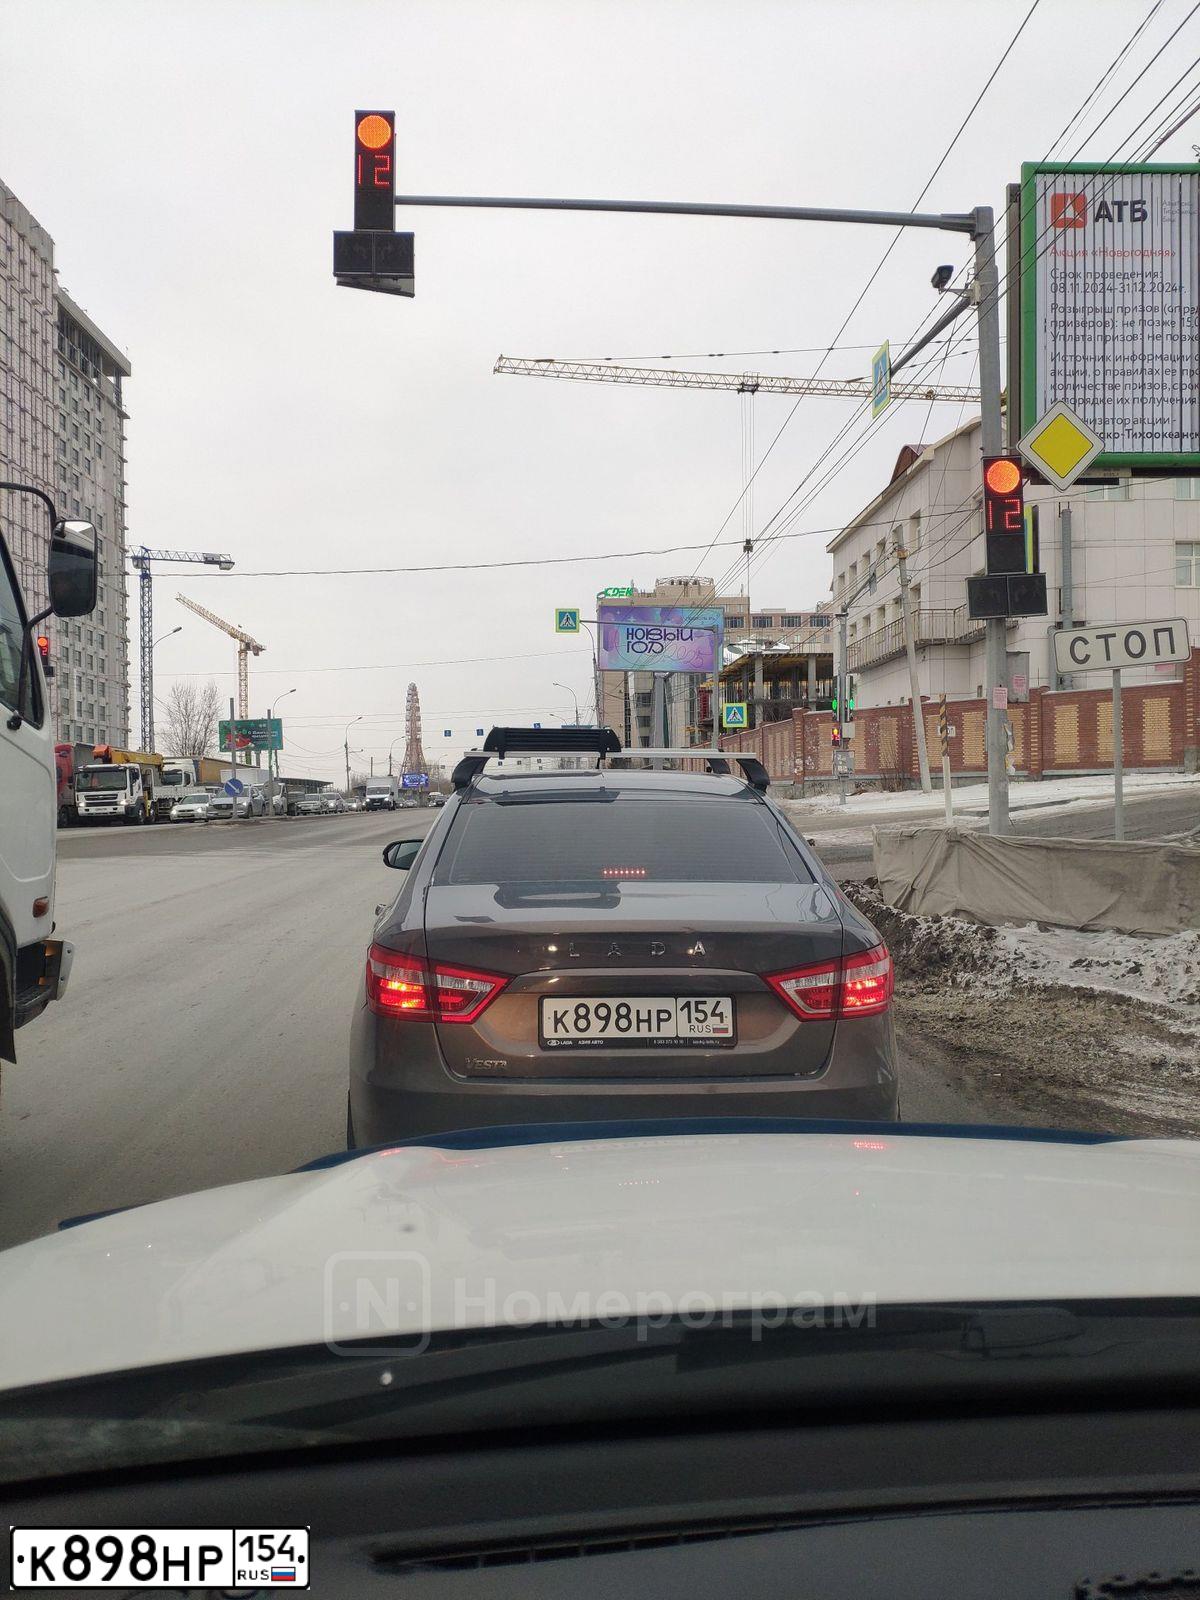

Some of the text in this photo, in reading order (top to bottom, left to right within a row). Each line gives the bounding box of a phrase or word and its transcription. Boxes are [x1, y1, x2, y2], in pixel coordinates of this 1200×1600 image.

[358, 155, 390, 185] 12
[1095, 200, 1148, 222] АТБ
[1049, 247, 1176, 258] Акция «Новогодняя»
[1050, 268, 1164, 281] Срок проведения:
[1050, 303, 1113, 315] Розыгрыш
[1116, 304, 1160, 315] призов
[1122, 320, 1135, 328] не
[1138, 318, 1177, 328] позже
[1050, 331, 1093, 343] Уплата
[1096, 333, 1144, 344] призов:
[1147, 334, 1162, 342] не
[1050, 352, 1112, 363] Источник
[1115, 351, 1192, 364] информации
[1050, 368, 1091, 378] акции,
[1094, 369, 1101, 377] о
[1105, 368, 1161, 379] правилах
[1050, 383, 1121, 391] количестве
[1124, 382, 1171, 392] призов,
[1062, 397, 1113, 408] порядке
[1116, 397, 1133, 405] их
[1081, 417, 1131, 428] низатор
[1133, 417, 1170, 427] акции
[1096, 428, 1200, 440] ско-Тихоокеанск
[988, 498, 1021, 529] 12
[1069, 627, 1175, 665] СТОП
[569, 941, 706, 957] LADA
[553, 1002, 673, 1034] К898НР
[679, 1000, 726, 1024] 154
[689, 1024, 711, 1034] RUS
